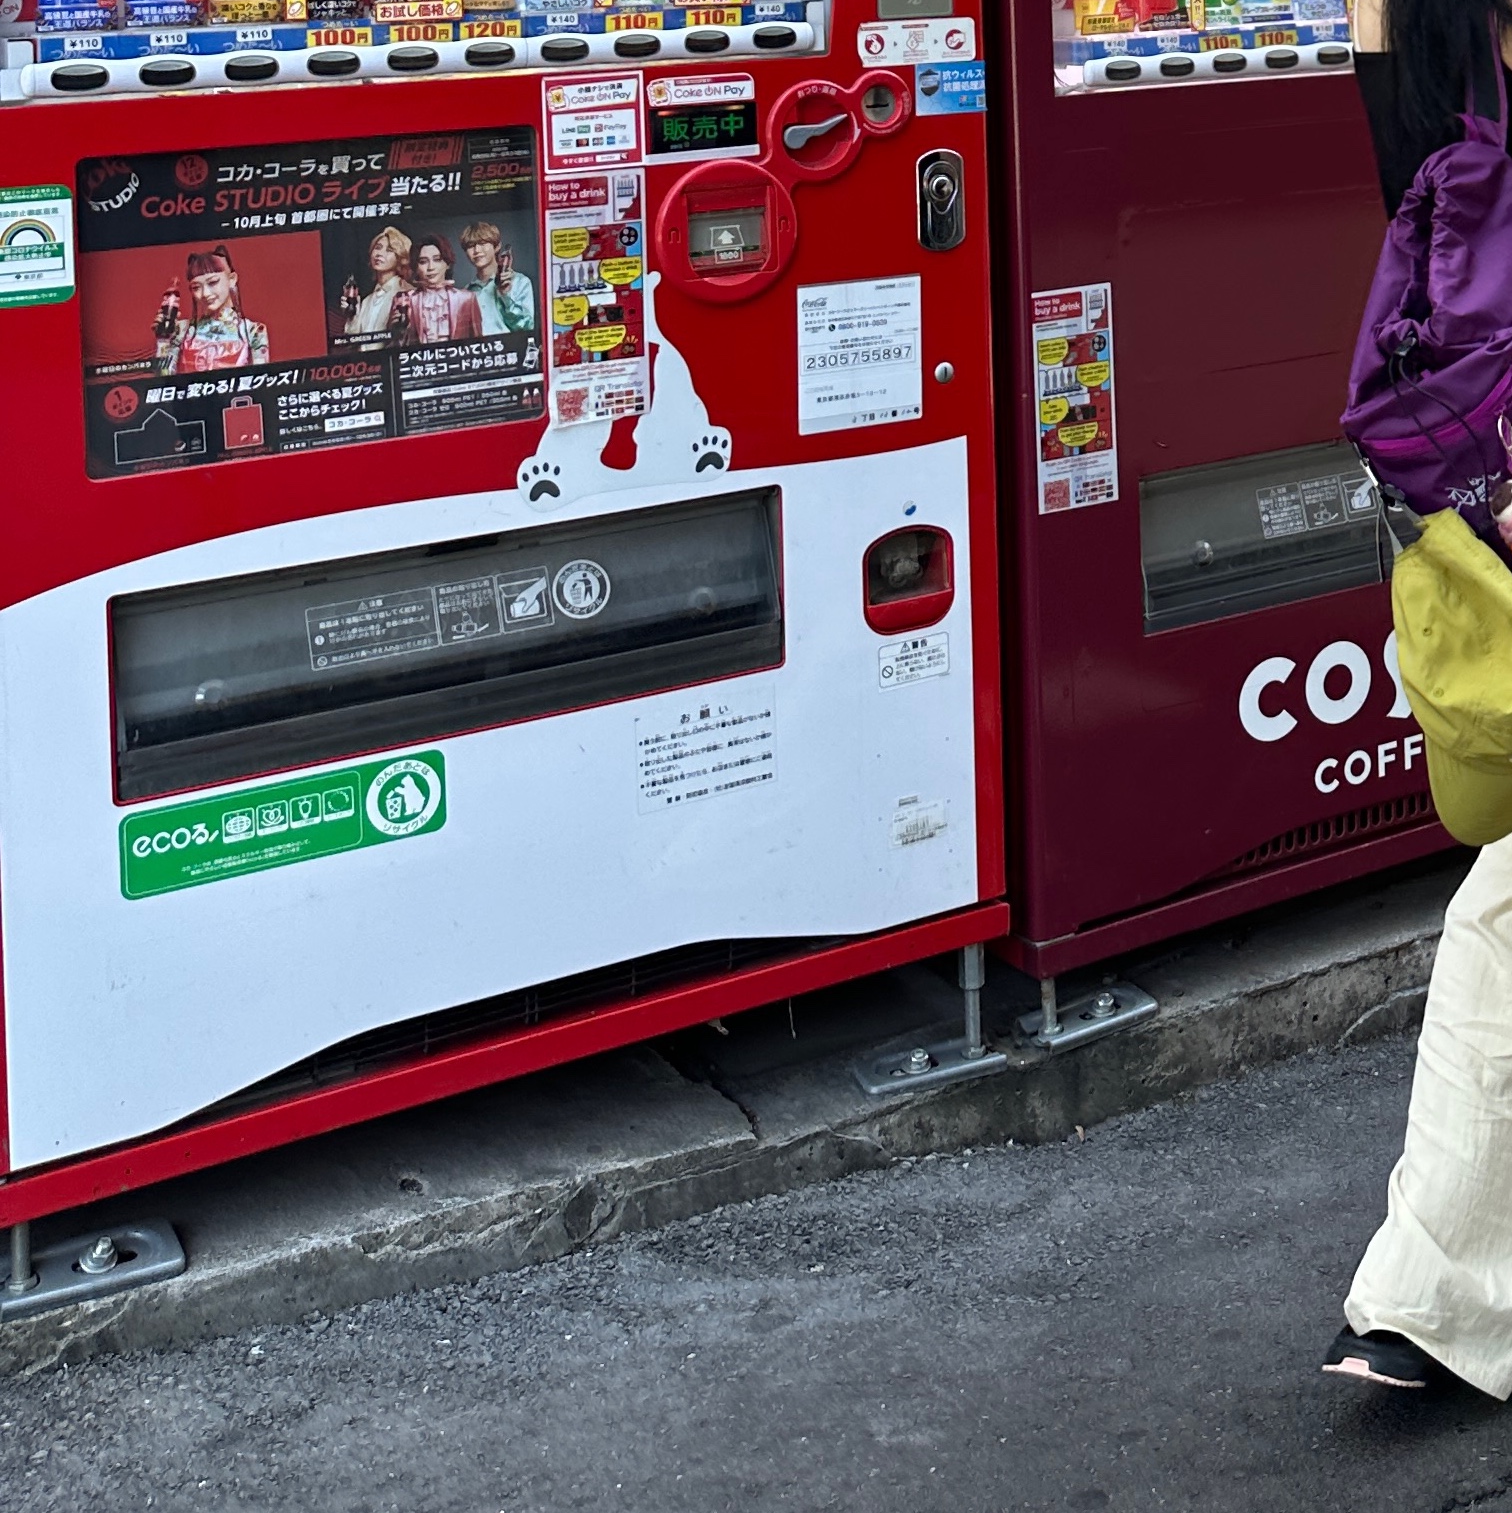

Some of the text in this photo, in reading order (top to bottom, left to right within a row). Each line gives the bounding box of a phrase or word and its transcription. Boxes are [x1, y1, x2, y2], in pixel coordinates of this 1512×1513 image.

[379, 2, 445, 18] お試し価格
[690, 8, 736, 25] 110円
[463, 21, 518, 39] 120円
[609, 14, 659, 30] 110円
[69, 37, 99, 50] ¥110
[154, 32, 184, 44] ¥110
[240, 29, 269, 40] ¥110
[311, 27, 369, 46] 100円
[1258, 30, 1294, 46] 110円
[613, 91, 632, 100] Pay
[673, 85, 703, 100] Coke
[723, 83, 746, 98] Pay
[662, 113, 745, 142] 販売中
[216, 152, 385, 184] コカ・コーラを買って
[140, 193, 206, 219] Coke
[212, 182, 317, 212] STUDIO
[321, 174, 390, 203] ライブ
[548, 189, 566, 203] buy
[579, 187, 606, 198] drink
[290, 202, 403, 225] 首都圏にて開催予定
[398, 339, 505, 364] ラベルについている
[805, 345, 912, 370] 2305755897
[398, 352, 519, 379] 二次元コードから応募
[276, 382, 383, 406] さらに選べる夏グッズ
[278, 398, 367, 421] ここからチェック!
[1313, 732, 1425, 794] COFF
